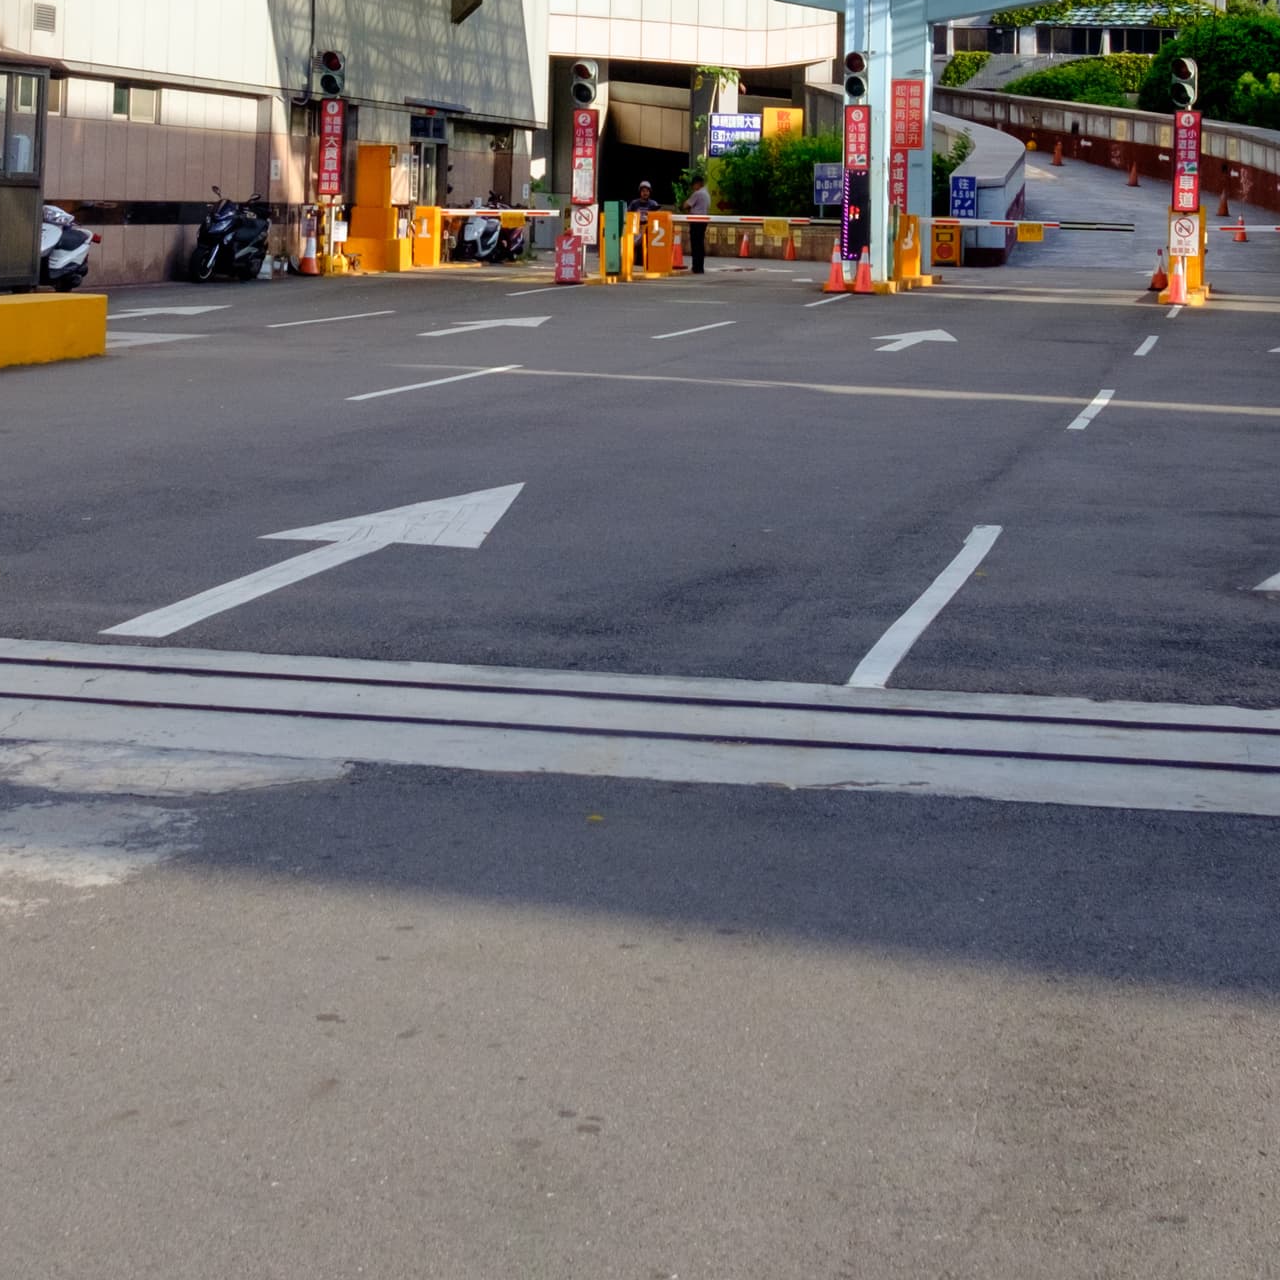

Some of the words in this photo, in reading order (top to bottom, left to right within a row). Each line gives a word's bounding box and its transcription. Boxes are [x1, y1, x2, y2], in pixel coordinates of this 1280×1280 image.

[1179, 176, 1194, 208] 車道
[418, 218, 431, 238] 1
[651, 226, 665, 246] 2
